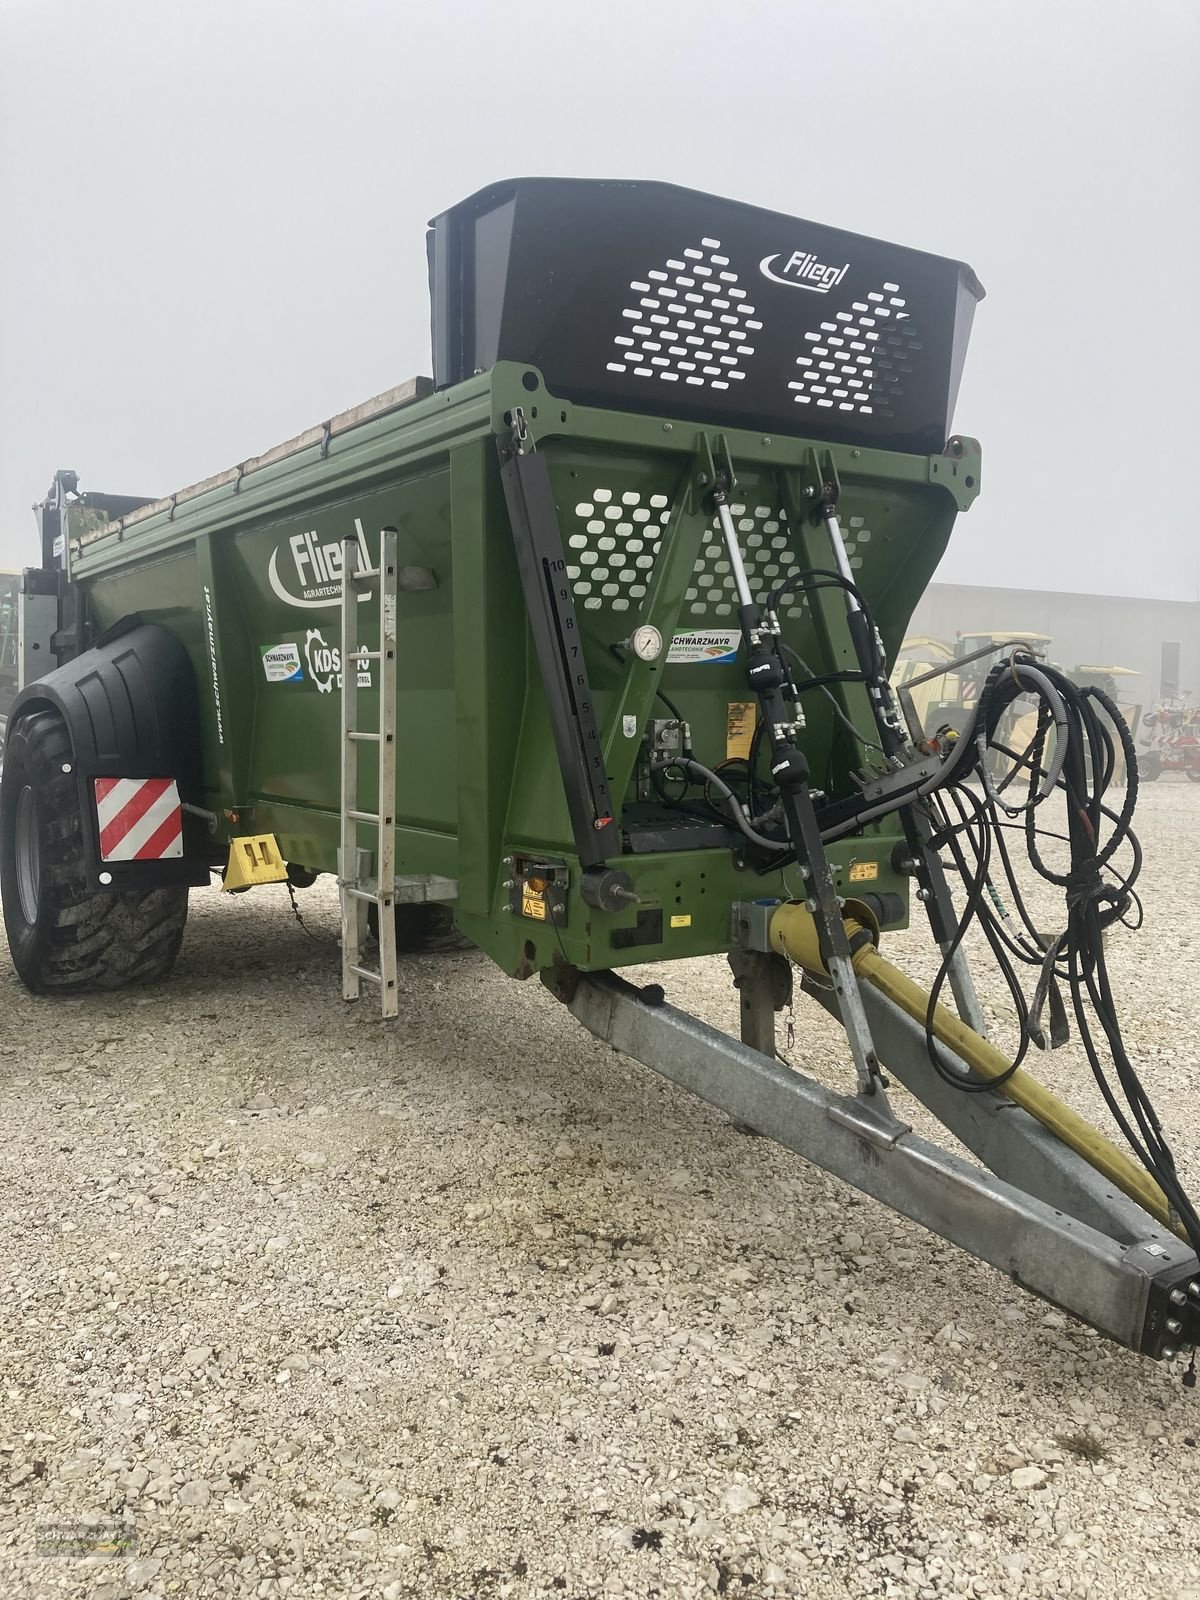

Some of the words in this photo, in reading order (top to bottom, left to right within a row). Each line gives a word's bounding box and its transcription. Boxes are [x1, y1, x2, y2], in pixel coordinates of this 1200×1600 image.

[783, 250, 850, 289] Fliegl
[289, 518, 373, 587] Fliel
[550, 559, 565, 572] 10
[303, 584, 342, 599] AGRARTECHN
[560, 589, 568, 600] 9
[566, 618, 574, 629] 8
[571, 646, 578, 658] 7
[203, 585, 225, 744] www.schwarzmayr.at
[314, 648, 341, 672] KDS
[577, 674, 585, 685] 6
[582, 702, 589, 713] 5
[588, 730, 595, 740] 4
[599, 785, 605, 795] 2
